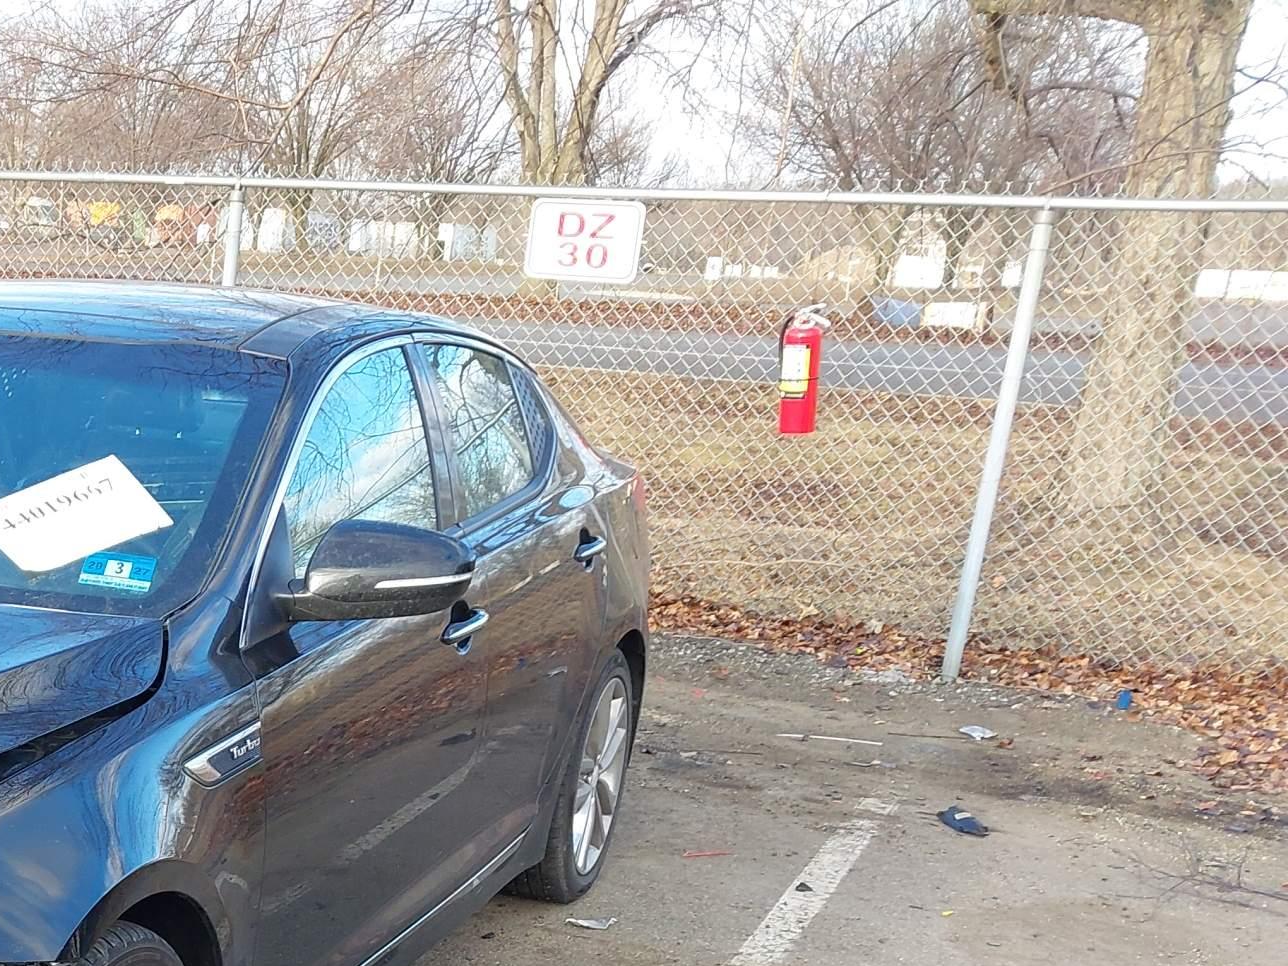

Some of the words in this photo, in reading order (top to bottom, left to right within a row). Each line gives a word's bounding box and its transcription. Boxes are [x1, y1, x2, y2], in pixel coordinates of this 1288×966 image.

[557, 211, 616, 239] DZ
[557, 241, 608, 269] 30
[115, 561, 124, 574] 3
[230, 737, 261, 760] Turbo
